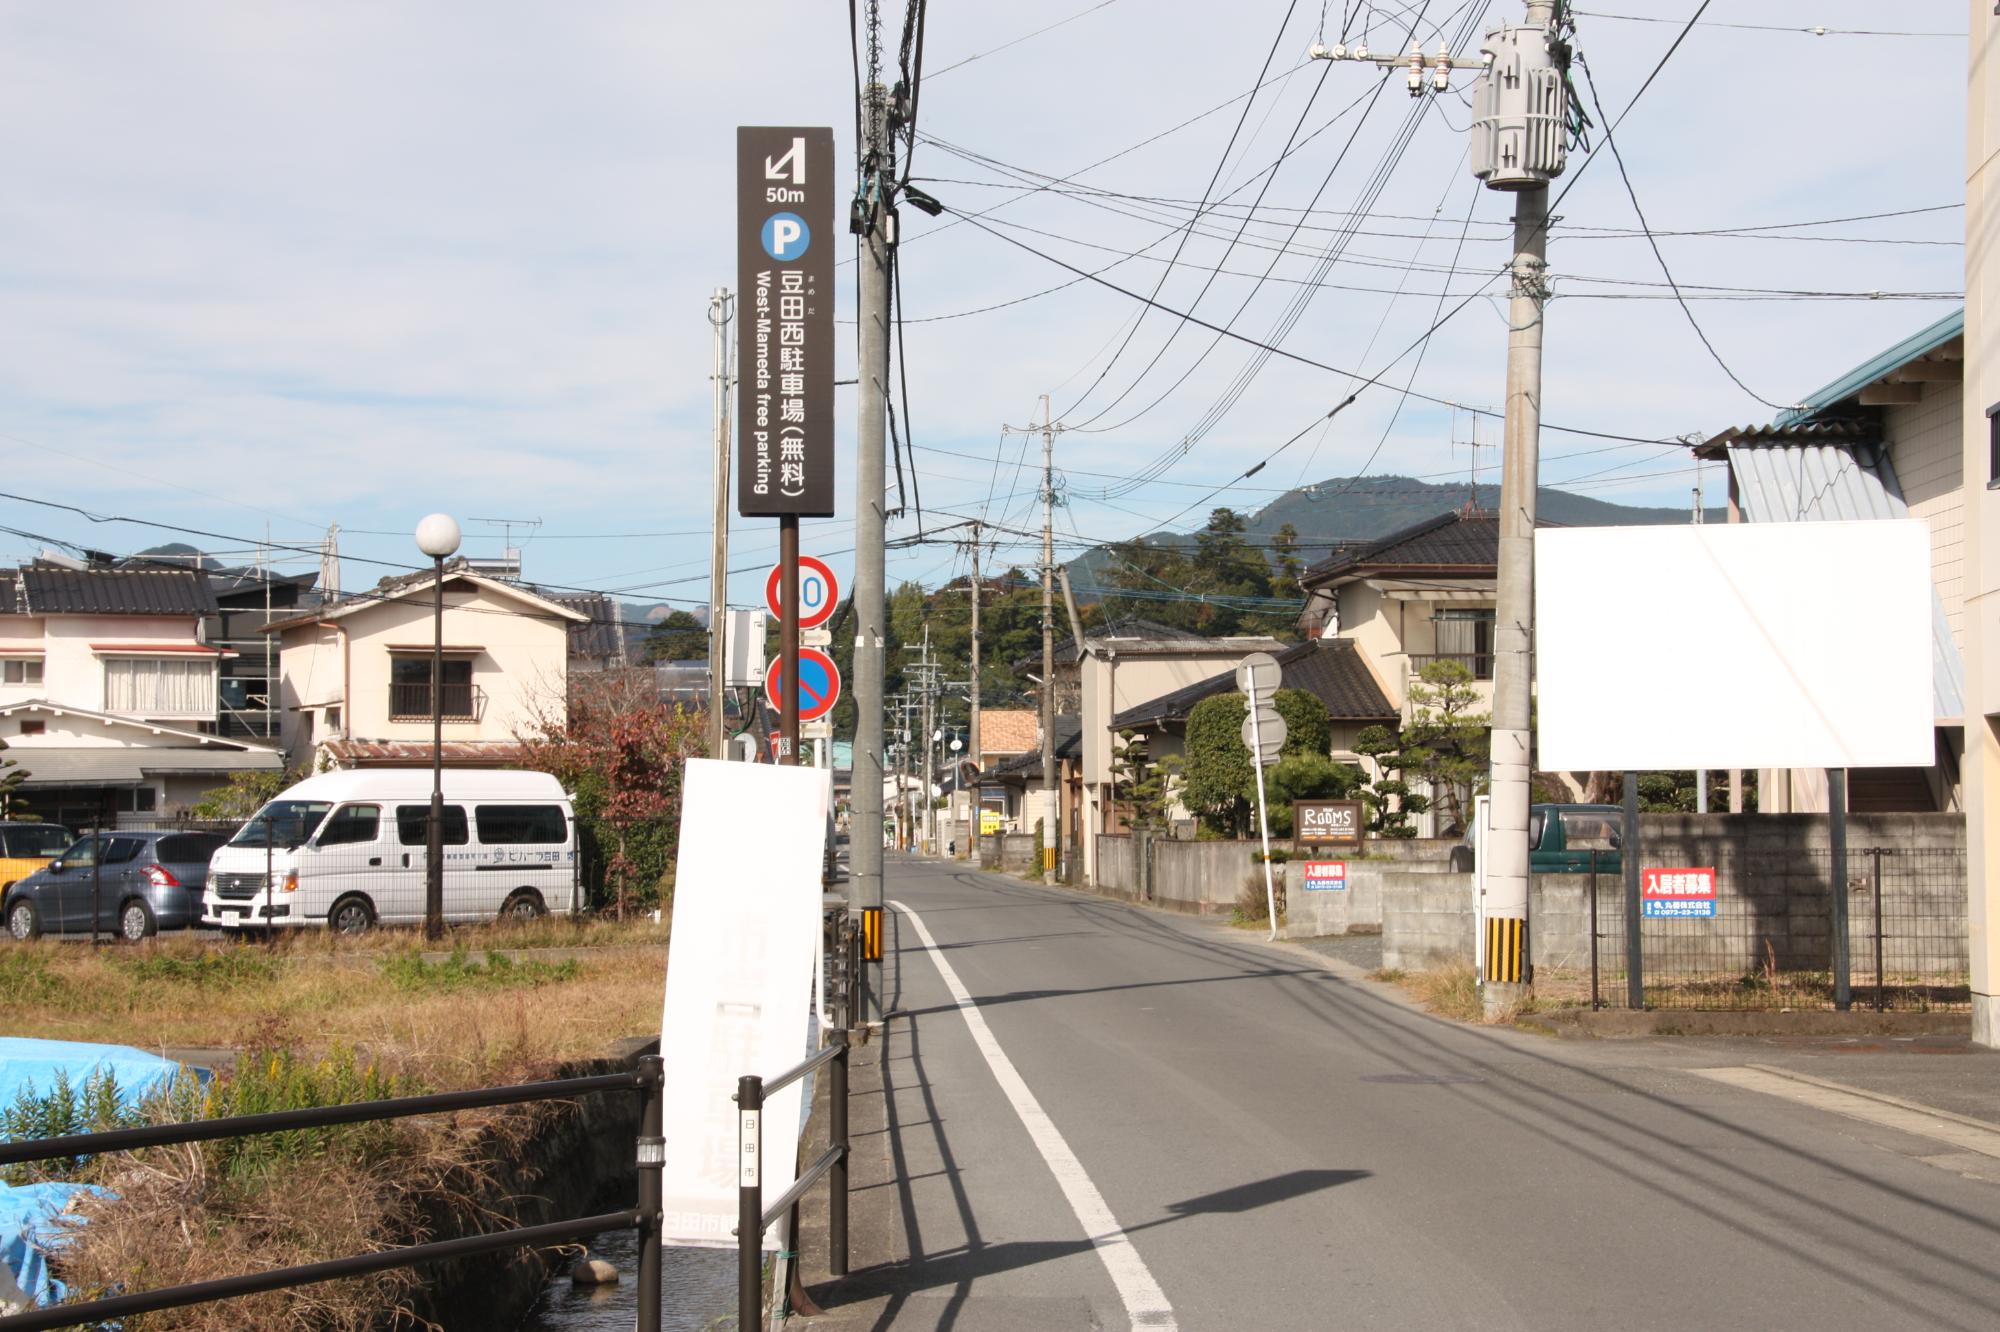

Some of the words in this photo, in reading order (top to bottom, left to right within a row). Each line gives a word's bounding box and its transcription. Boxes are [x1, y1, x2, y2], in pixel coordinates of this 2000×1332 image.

[766, 187, 805, 203] 50m
[774, 219, 801, 255] P
[756, 270, 771, 389] West-Mameda
[756, 393, 771, 427] free
[754, 431, 771, 495] parking
[1647, 873, 1711, 895] 入居者募集
[744, 1119, 755, 1177] 日田市
